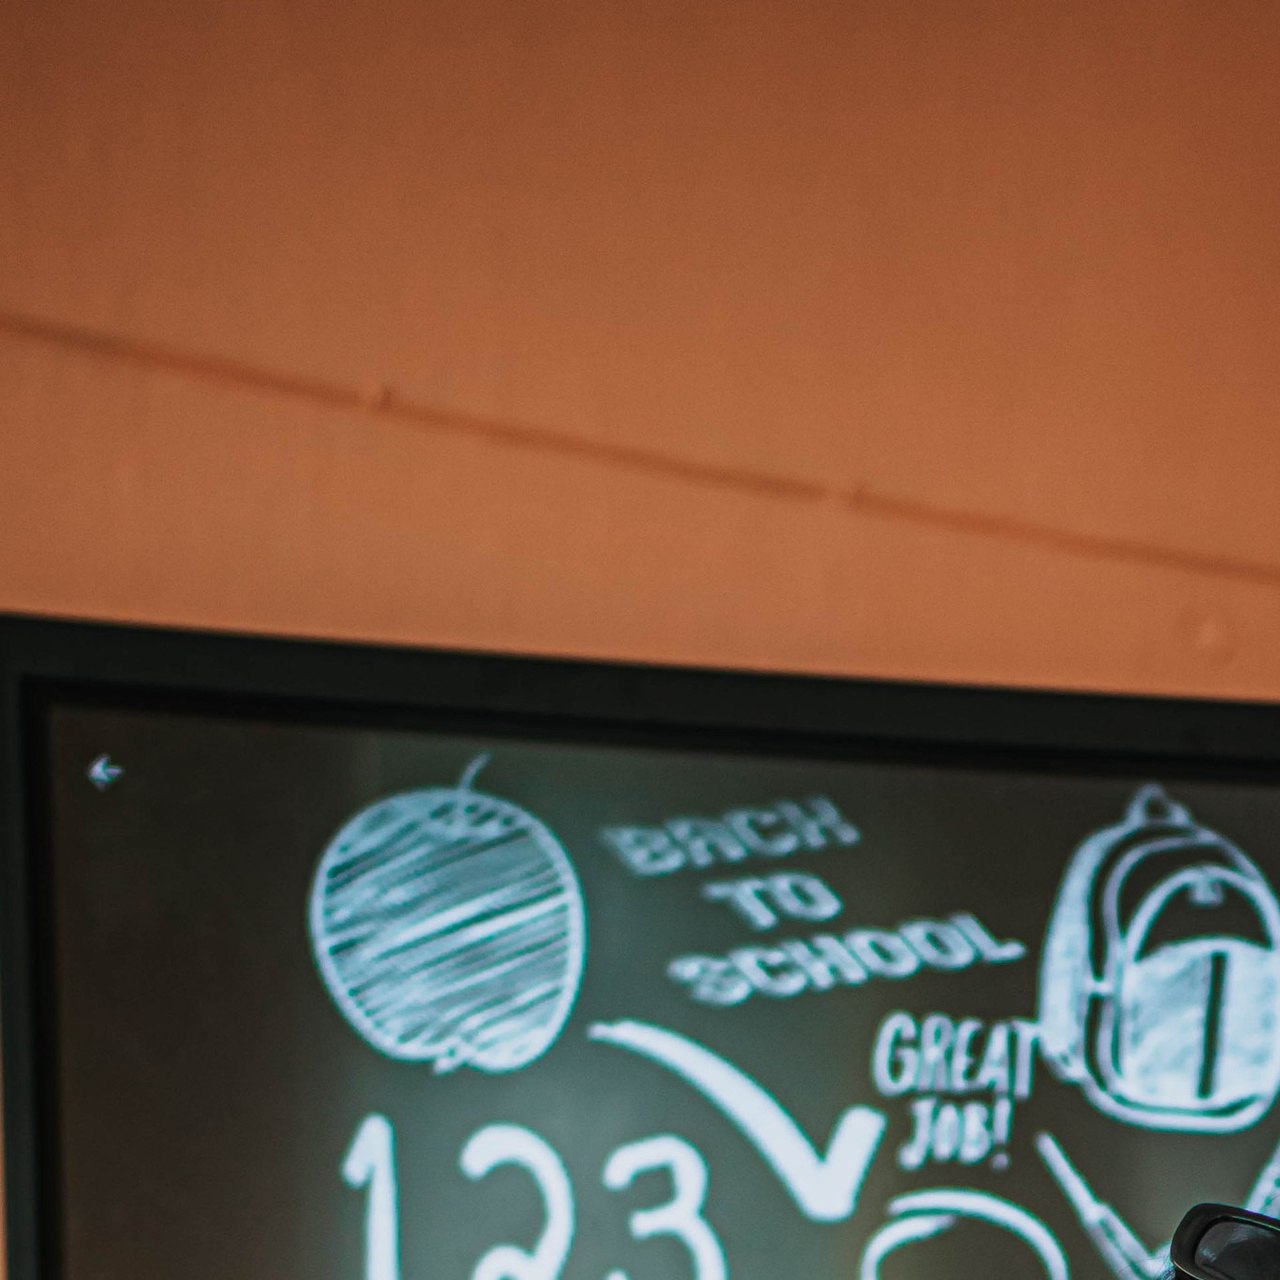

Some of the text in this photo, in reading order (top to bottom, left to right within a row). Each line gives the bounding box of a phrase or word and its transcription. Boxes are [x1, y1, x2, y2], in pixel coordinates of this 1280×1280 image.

[704, 872, 843, 930] TO
[666, 912, 1028, 1006] SCHOOL
[871, 1011, 1044, 1100] GREAT
[897, 1097, 1013, 1169] JOB!
